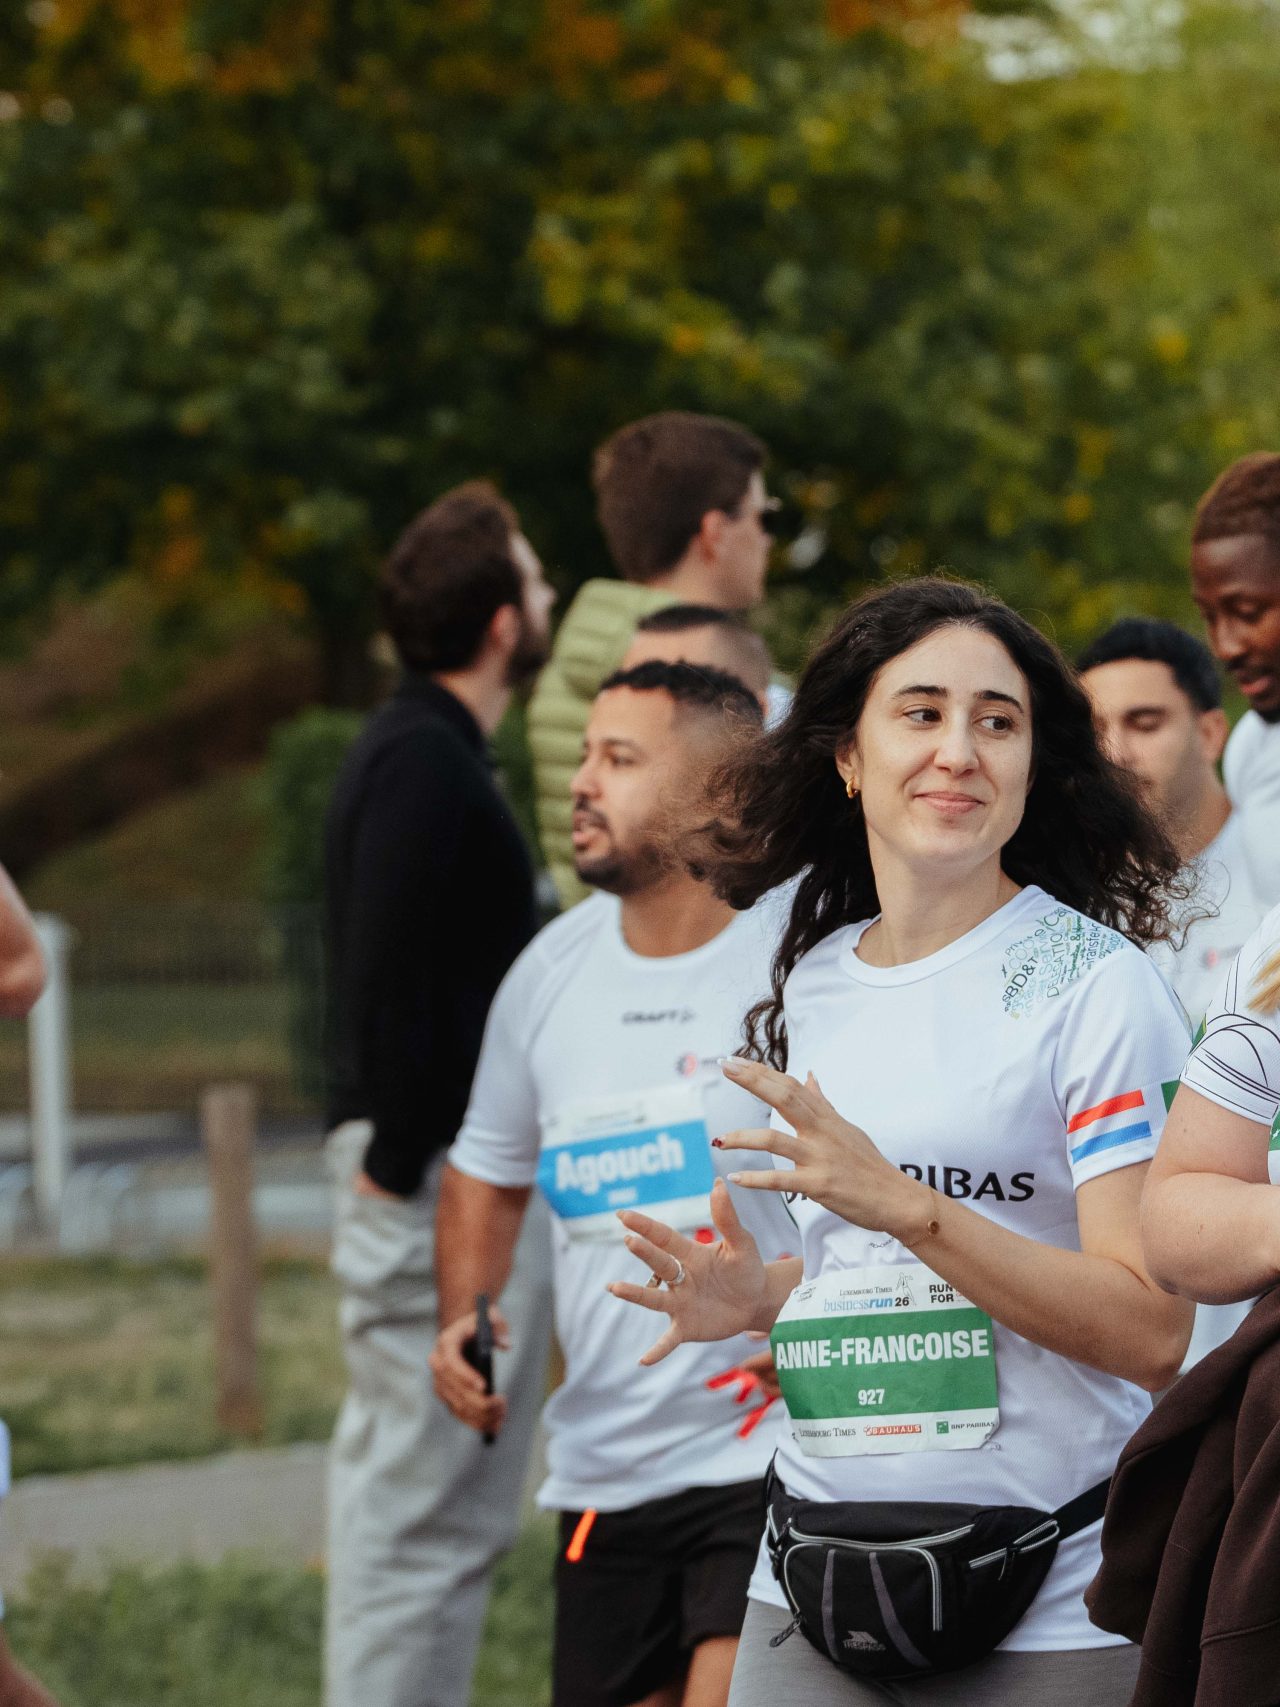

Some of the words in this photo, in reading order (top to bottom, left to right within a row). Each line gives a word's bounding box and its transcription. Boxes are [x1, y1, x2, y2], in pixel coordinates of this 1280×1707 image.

[555, 1132, 685, 1196] Agouch
[929, 1283, 953, 1294] RUN
[894, 1296, 910, 1307] 26
[930, 1293, 954, 1304] FOR
[776, 1329, 990, 1370] ANNE-FRANCOISE
[857, 1388, 885, 1406] 927
[872, 1423, 921, 1435] BAUHAUS
